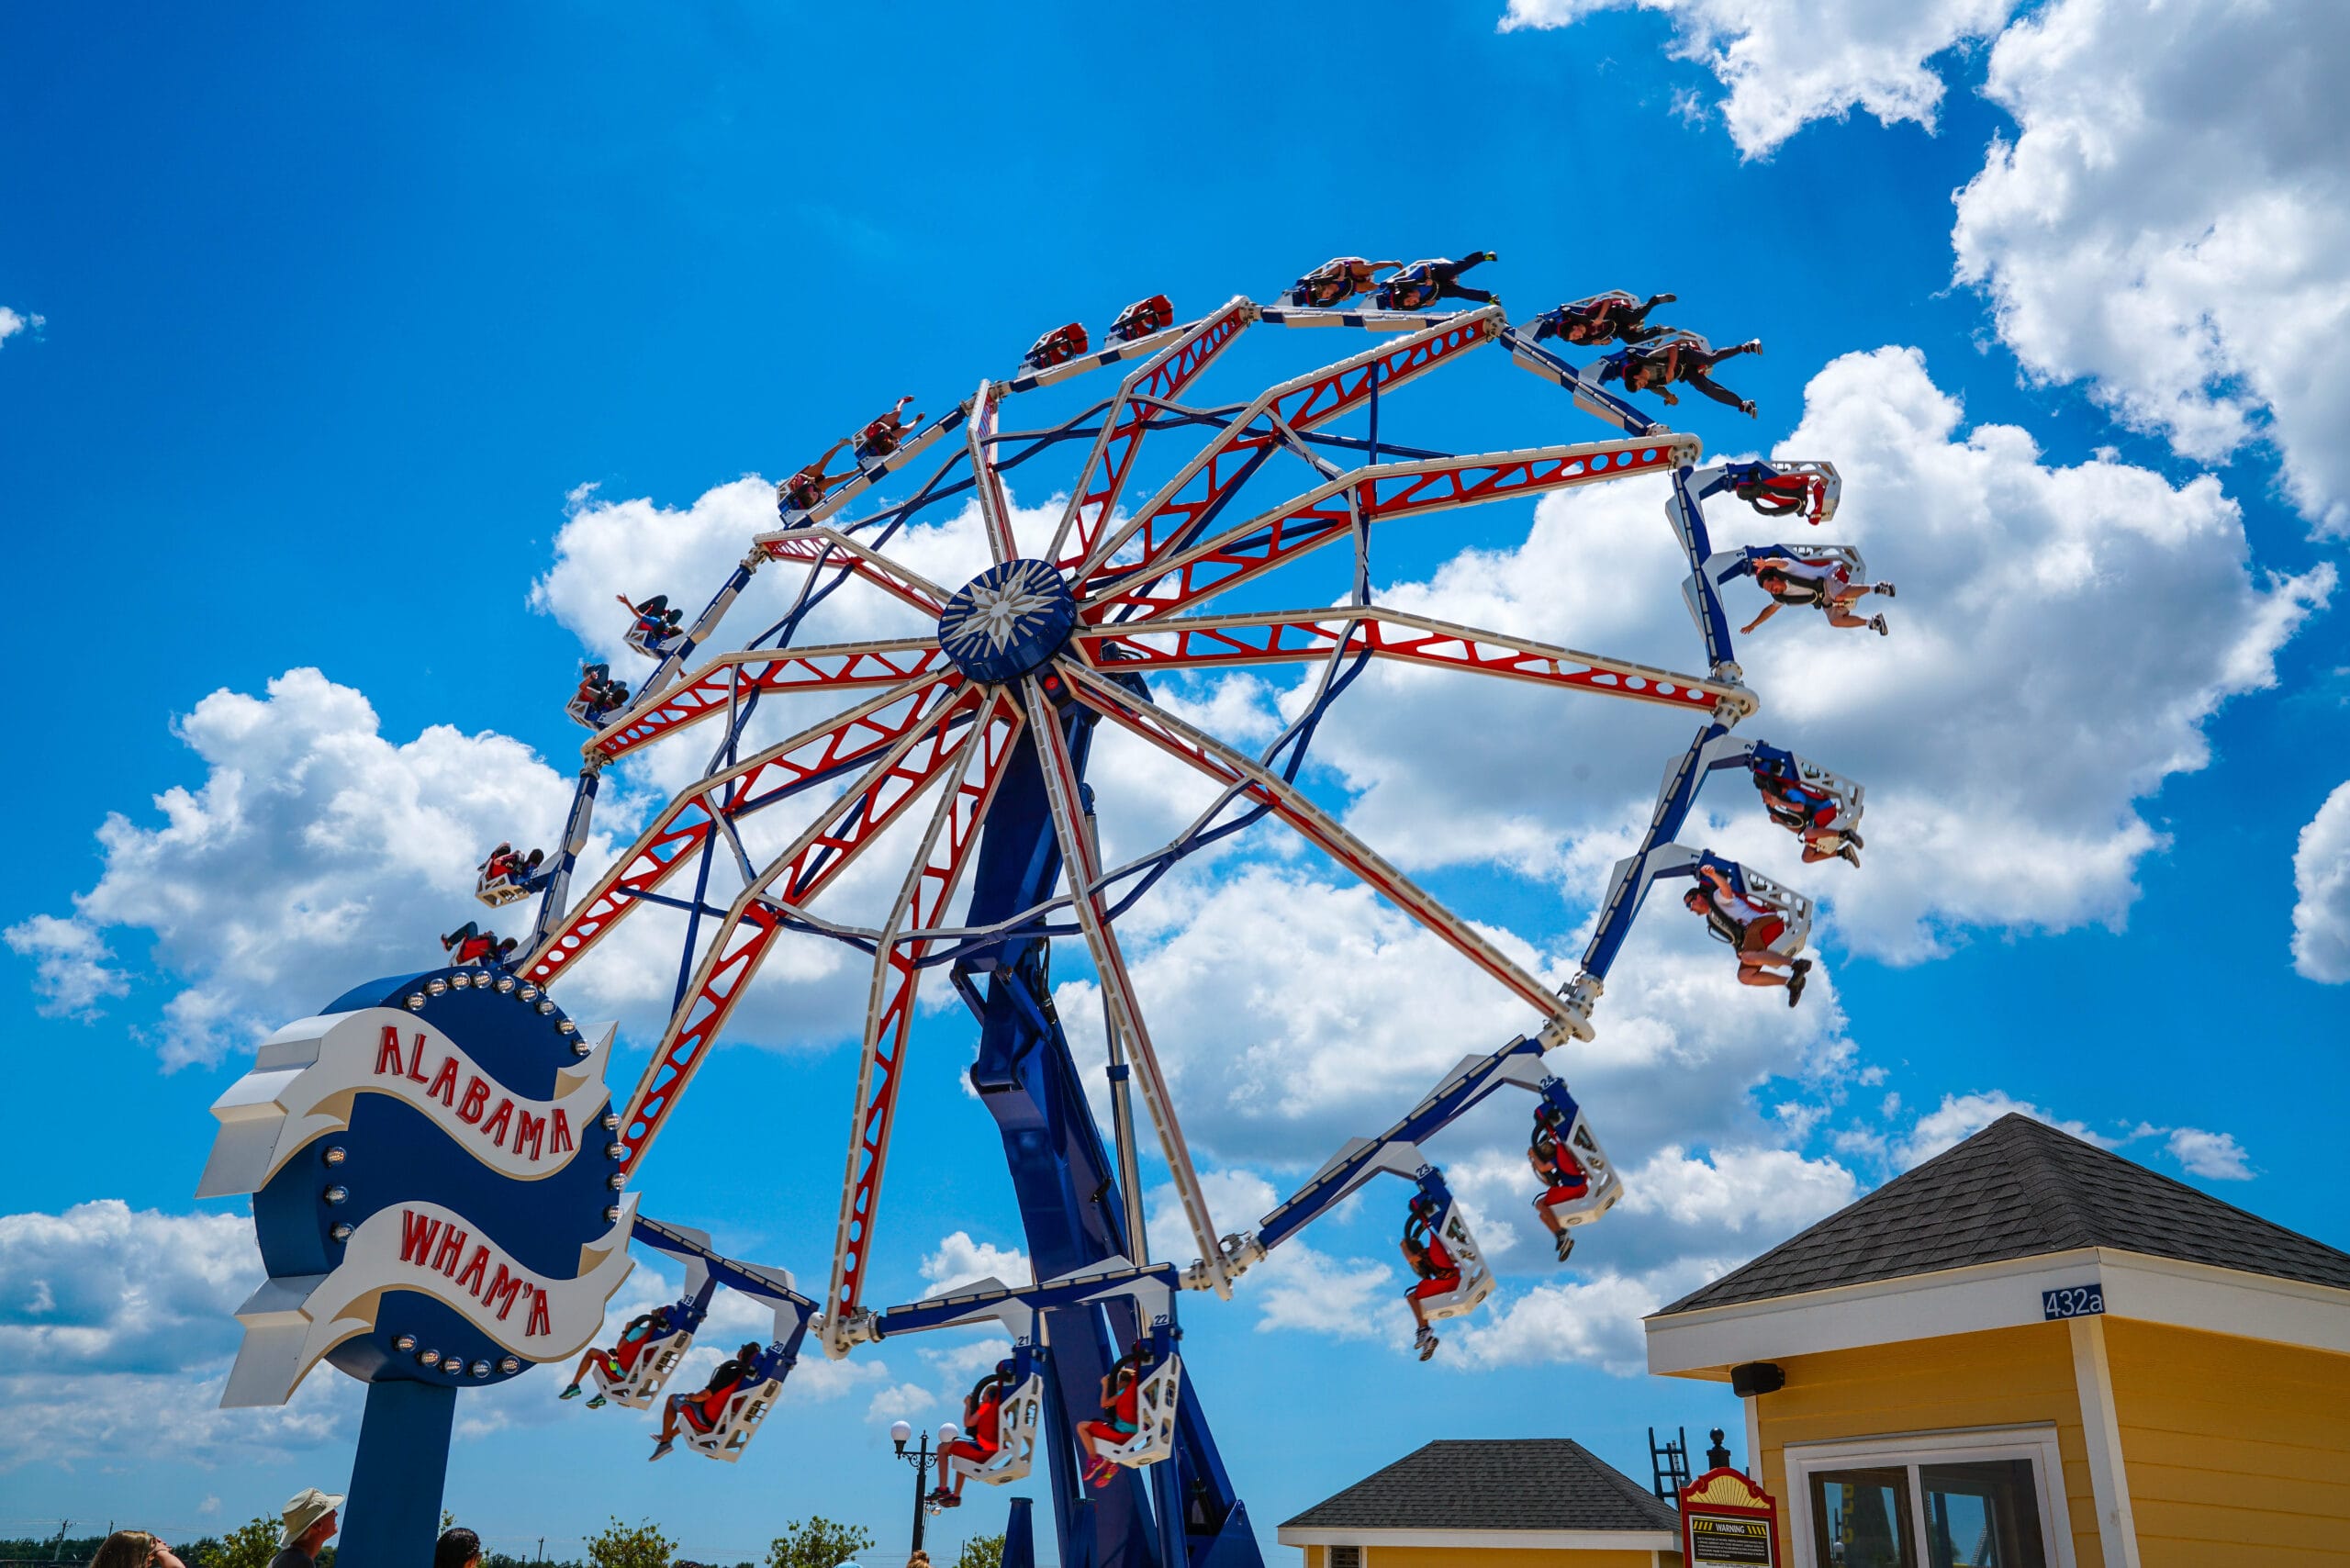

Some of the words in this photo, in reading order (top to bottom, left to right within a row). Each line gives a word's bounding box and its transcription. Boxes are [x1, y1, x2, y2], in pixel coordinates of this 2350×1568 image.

[1540, 1074, 1554, 1088] 24
[374, 1025, 574, 1161] ALABAMA
[1416, 1163, 1430, 1177] 23
[400, 1210, 551, 1337] WHAM'A
[684, 1294, 694, 1305] 19
[2046, 1288, 2103, 1316] 432a
[1154, 1315, 1168, 1325] 22
[772, 1340, 784, 1351] 20
[1018, 1335, 1029, 1345] 21
[1716, 1523, 1744, 1533] WARNING
